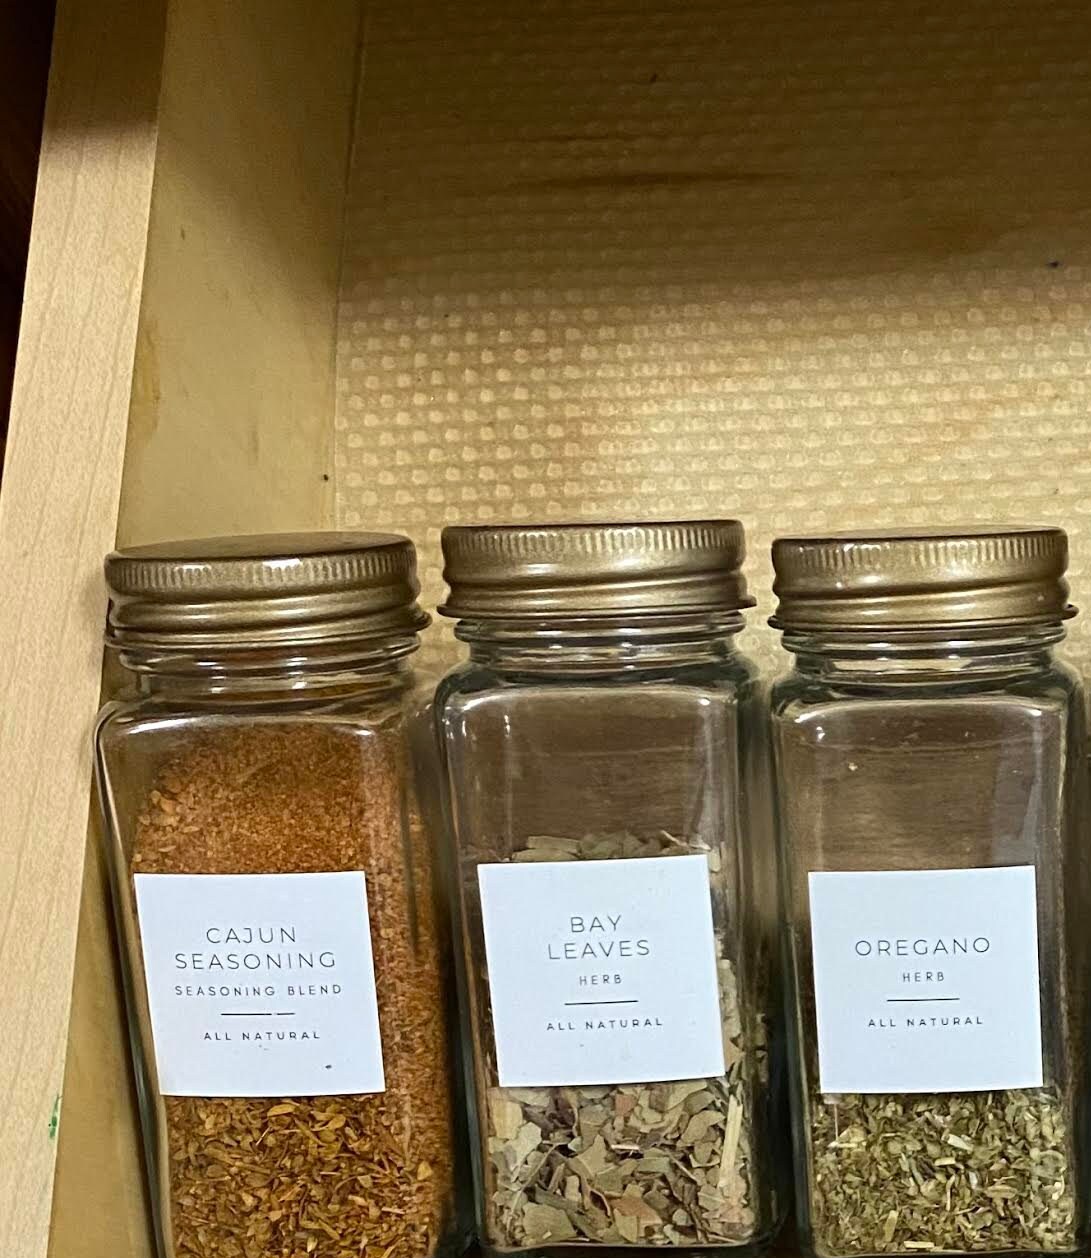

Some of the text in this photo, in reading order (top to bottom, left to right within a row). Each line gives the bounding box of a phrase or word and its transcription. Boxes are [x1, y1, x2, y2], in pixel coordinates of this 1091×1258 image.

[570, 915, 622, 933] BAY
[206, 927, 296, 944] CAJUN
[547, 940, 650, 960] LEAVES
[855, 937, 991, 956] OREGANO
[175, 952, 336, 970] SEASONING
[579, 974, 622, 986] HERB
[902, 971, 945, 983] HERB
[175, 984, 342, 997] SEASONING BLEND
[546, 1018, 663, 1031] ALL NATURAL
[868, 1016, 984, 1027] ALL NATURAL
[204, 1031, 321, 1041] ALL NATURAL
